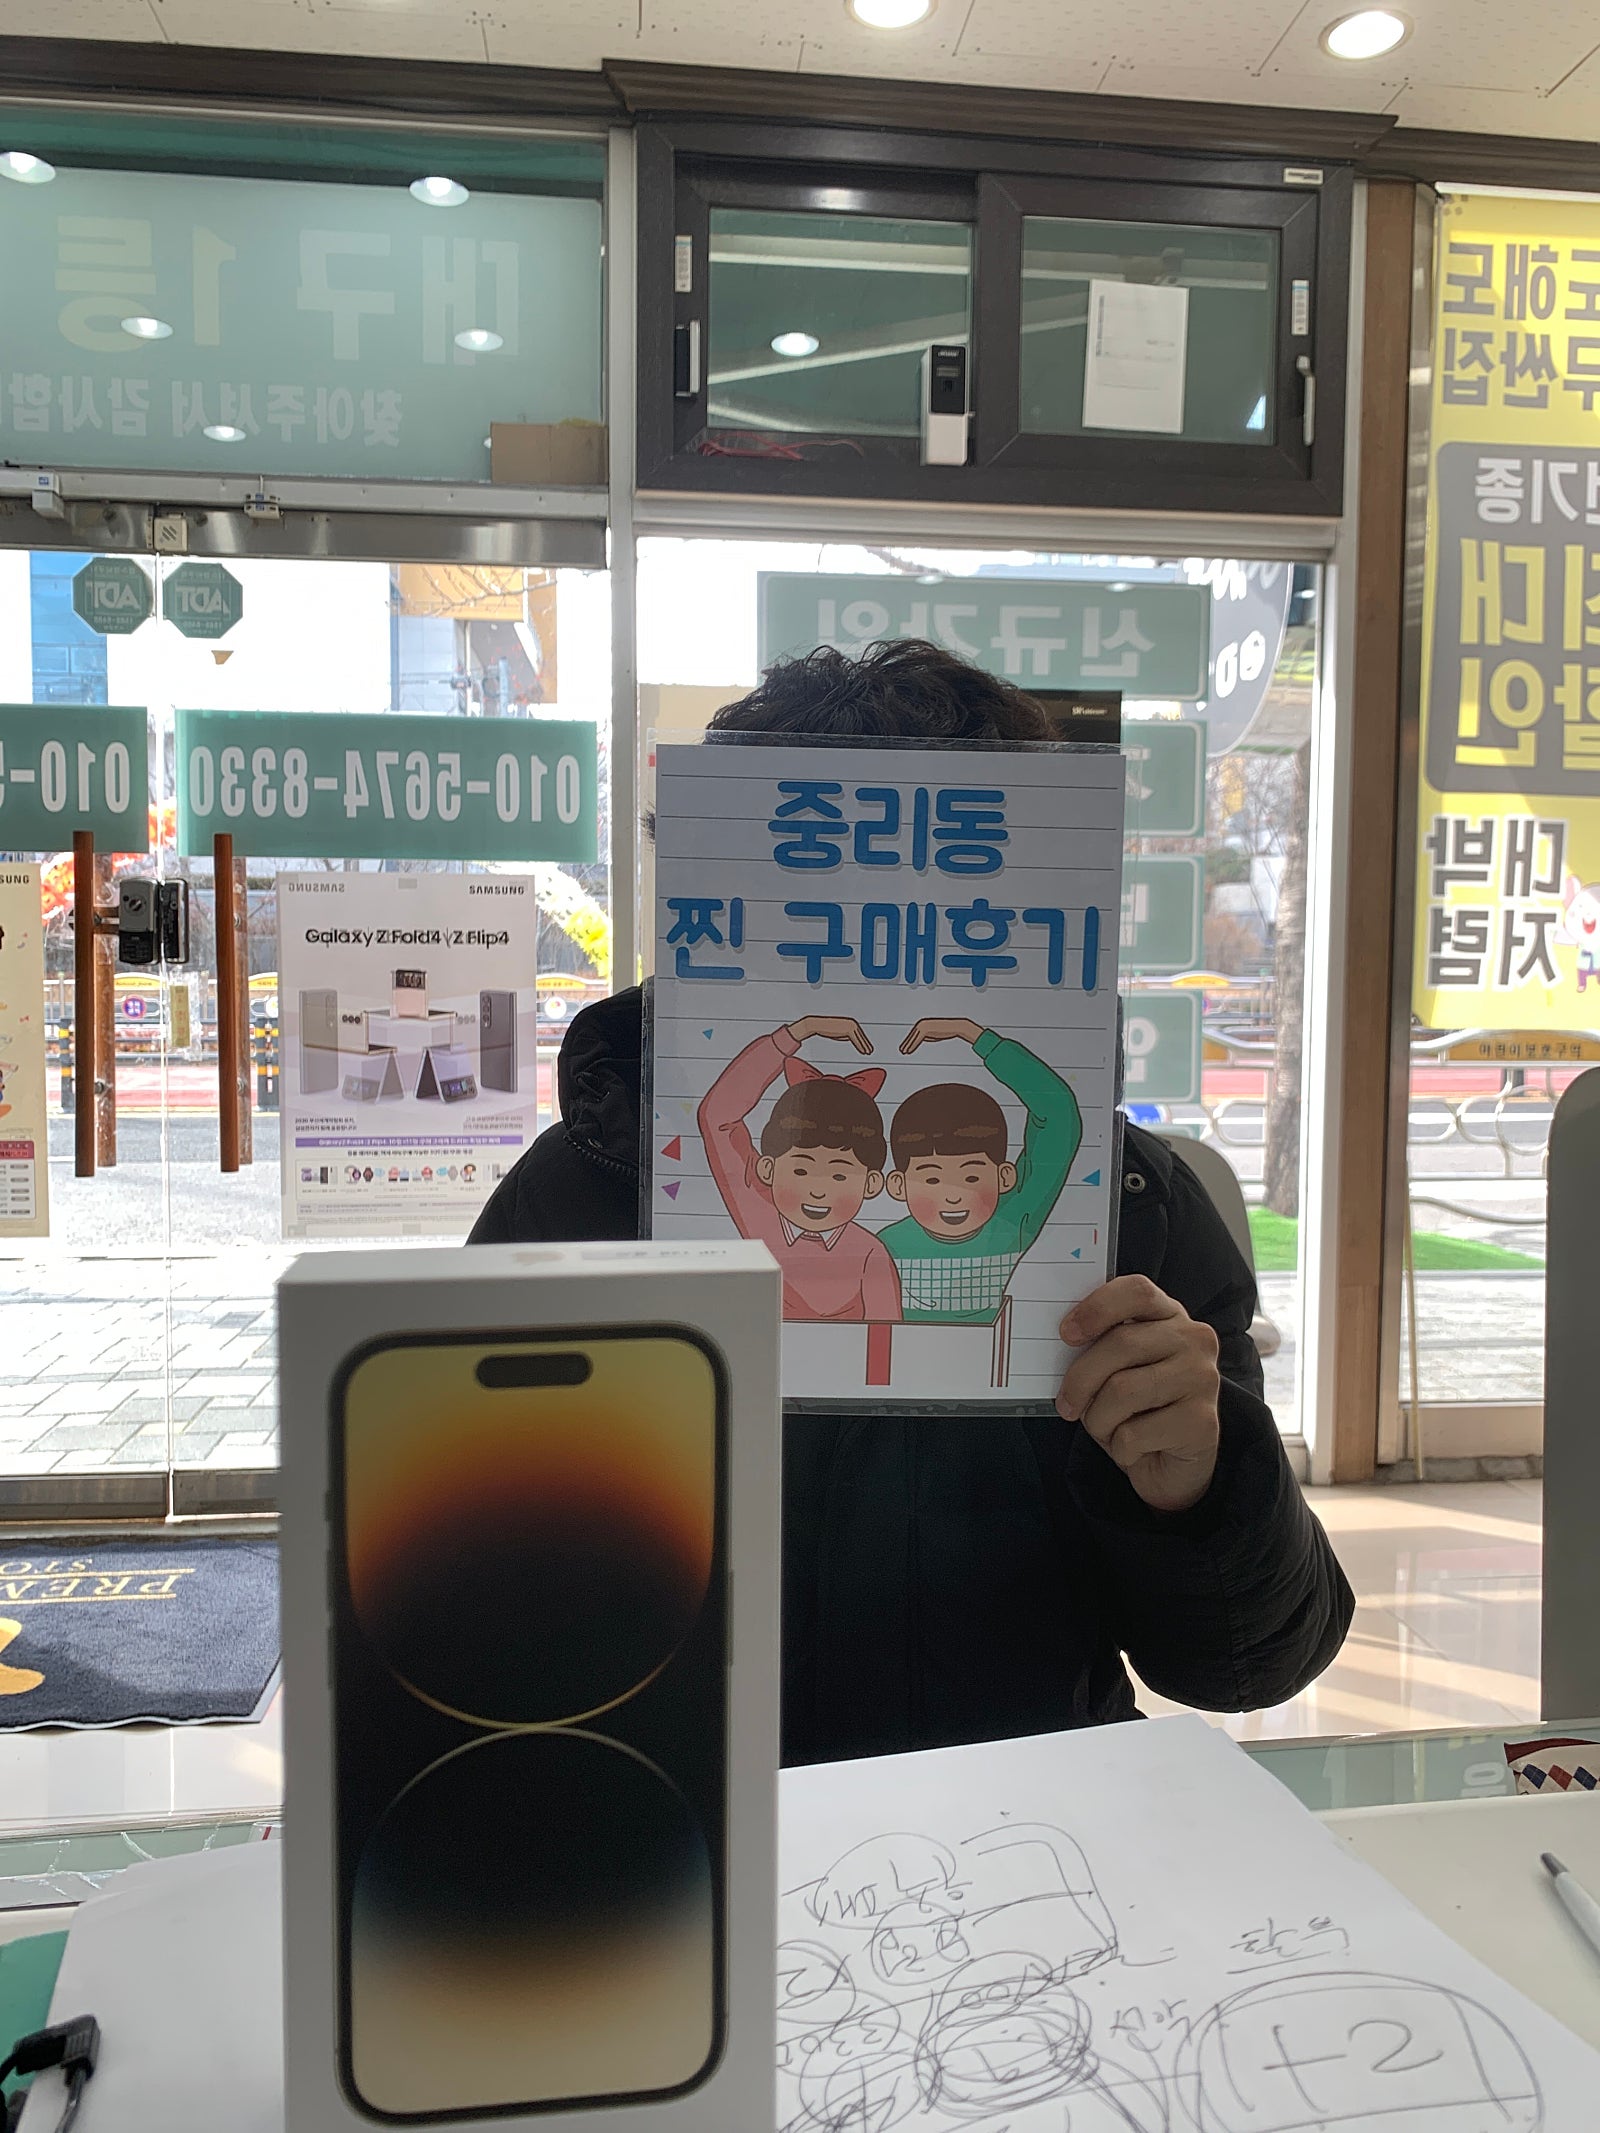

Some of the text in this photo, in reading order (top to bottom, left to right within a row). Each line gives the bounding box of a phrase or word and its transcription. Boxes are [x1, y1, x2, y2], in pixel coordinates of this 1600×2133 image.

[768, 780, 1009, 875] 중리동
[469, 884, 525, 895] SAMSUNG
[305, 928, 373, 948] Galaxy
[376, 930, 388, 944] Z
[391, 928, 442, 945] Fold4
[453, 930, 464, 944] Z
[468, 929, 509, 949] Flip4
[665, 896, 745, 981] 찐
[776, 897, 1101, 992] 구매후기
